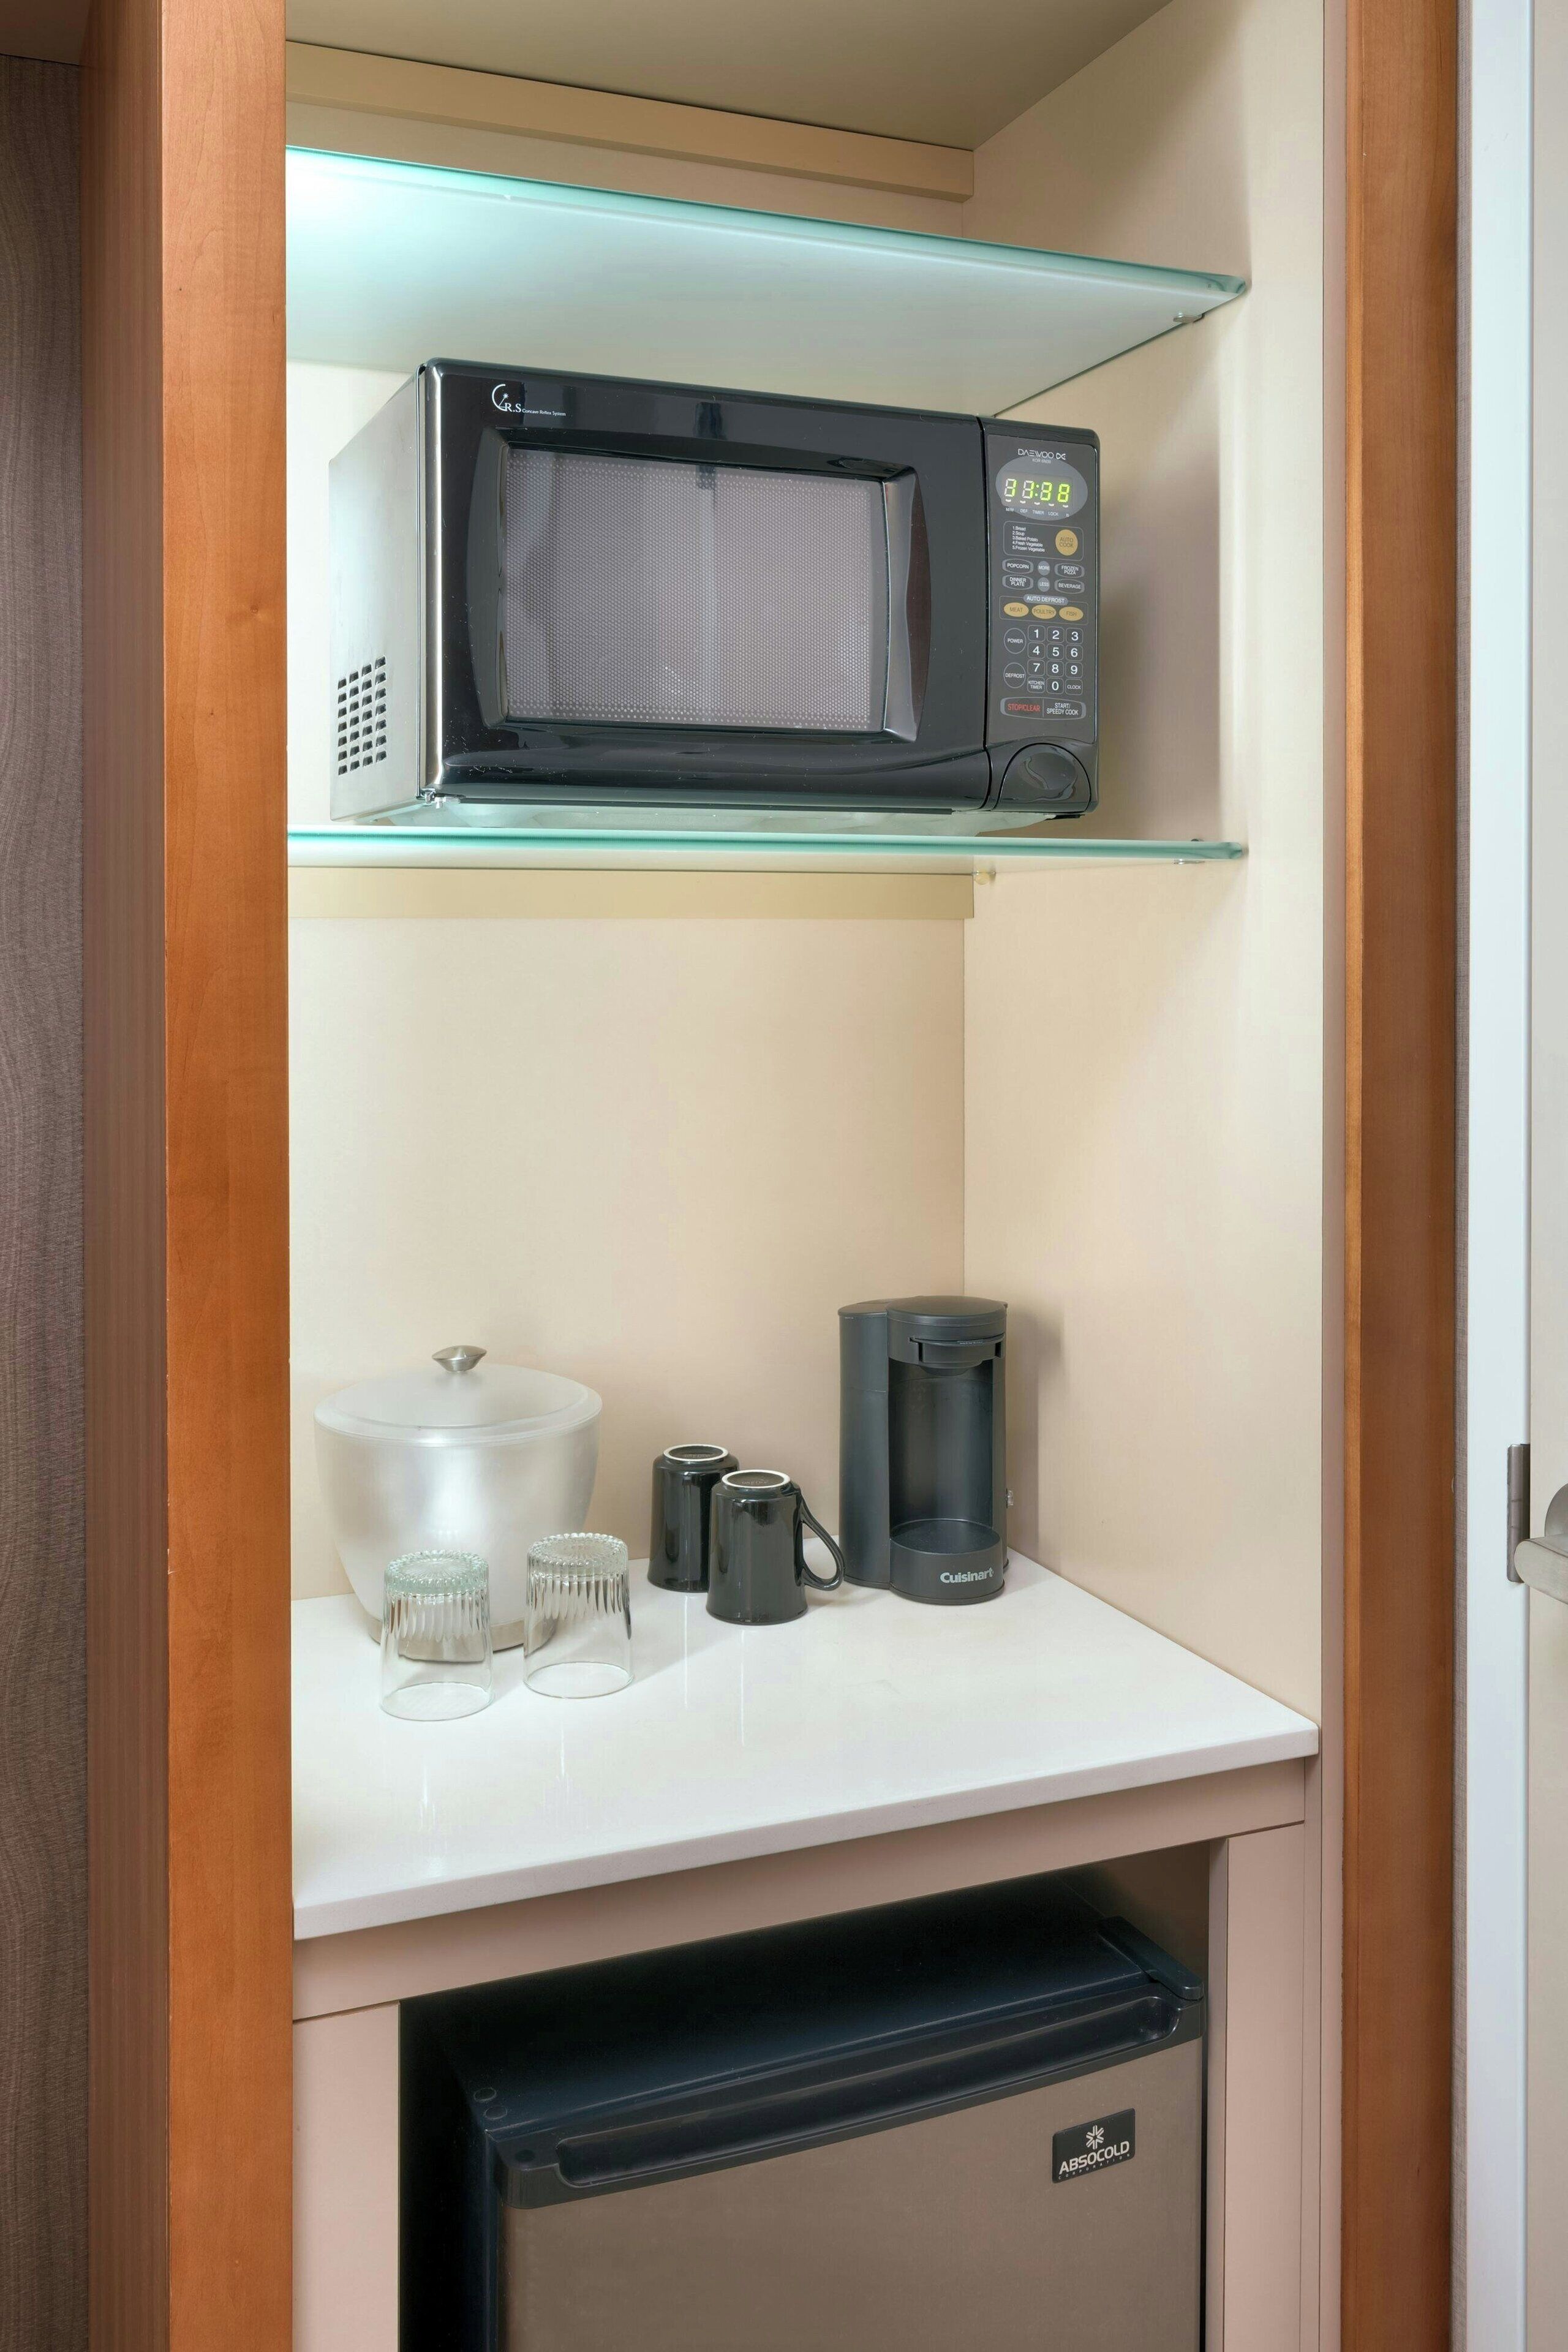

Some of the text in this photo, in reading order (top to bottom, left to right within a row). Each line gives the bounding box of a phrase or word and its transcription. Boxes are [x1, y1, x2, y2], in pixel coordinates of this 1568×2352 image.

[1018, 448, 1054, 459] DAEWOO
[1034, 629, 1039, 638] 1
[1052, 630, 1060, 639] 2
[1071, 631, 1079, 641] 3
[1033, 646, 1040, 655] 4
[1052, 647, 1060, 657] 5
[1071, 648, 1078, 657] 6
[1033, 663, 1040, 672] 7
[1052, 664, 1059, 673] 8
[1071, 665, 1078, 674] 9
[1052, 681, 1059, 690] 0
[1008, 703, 1040, 712] STOP/CLEAR
[940, 1567, 993, 1583] Cuisinart
[1059, 2141, 1129, 2175] ABSOCOLD
[1058, 2154, 1130, 2180] CORPORATION
